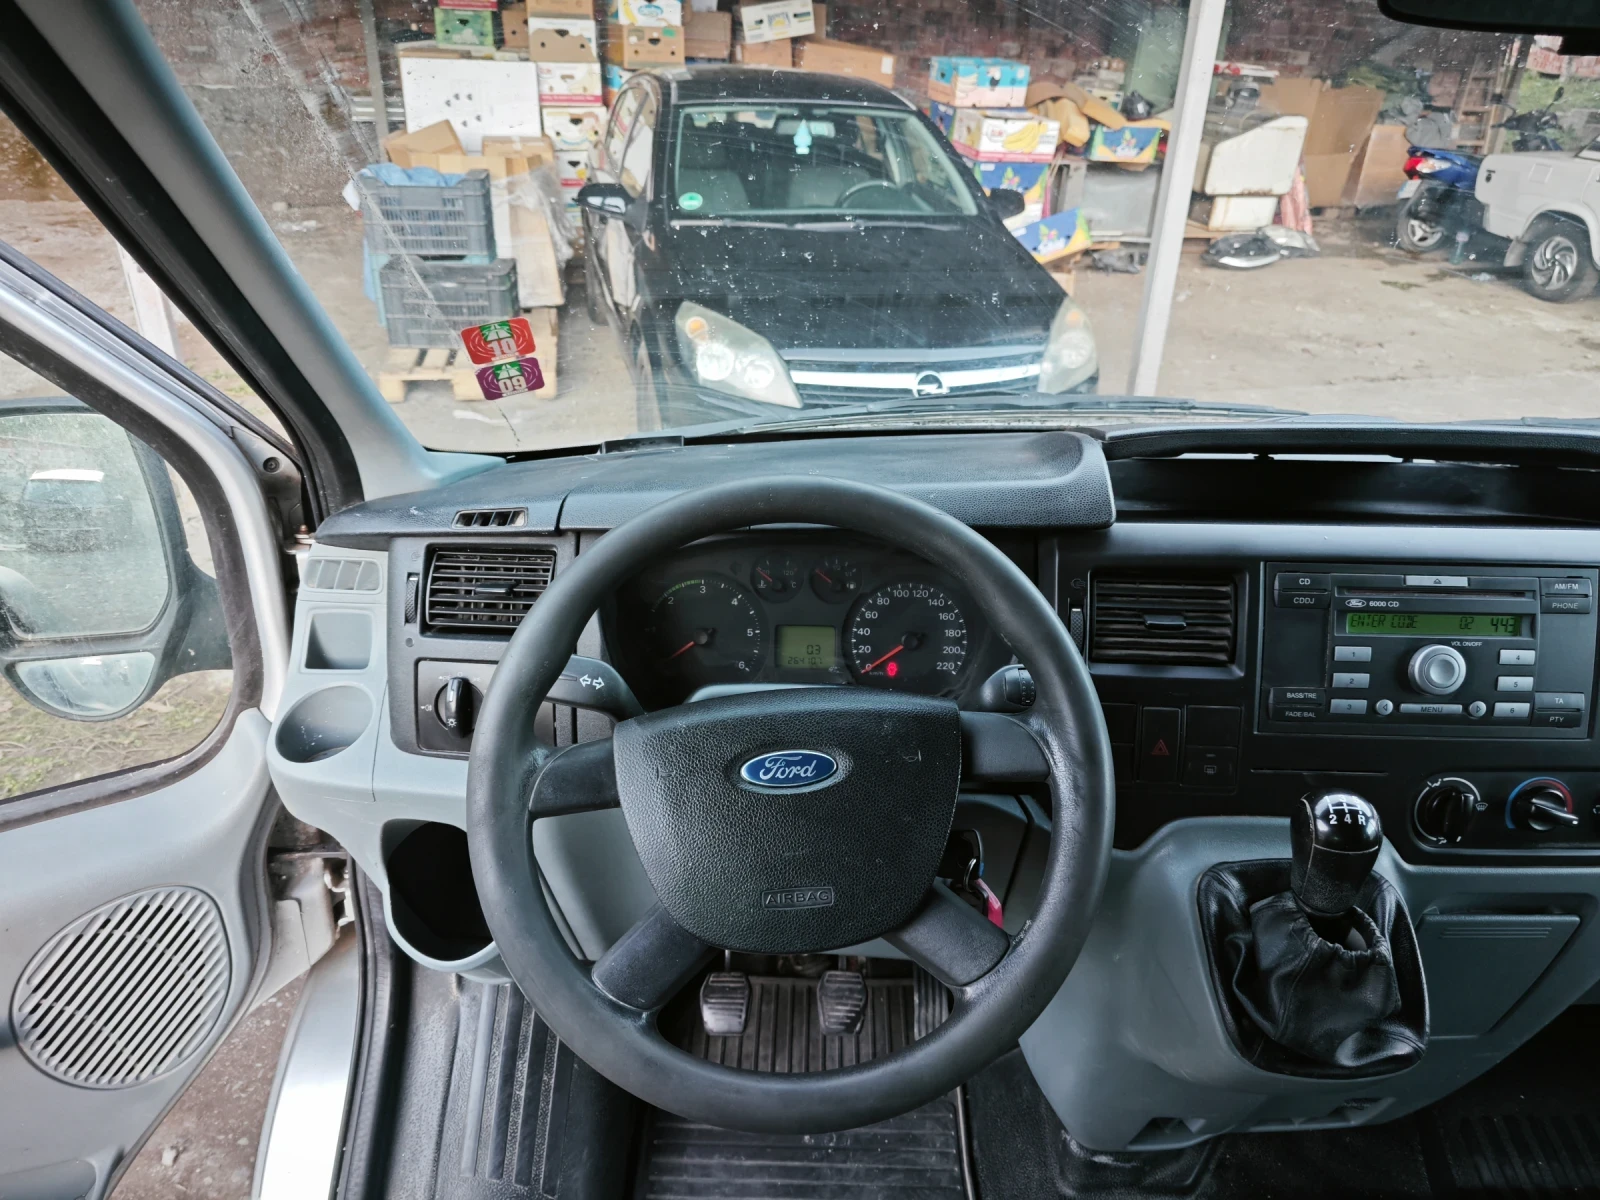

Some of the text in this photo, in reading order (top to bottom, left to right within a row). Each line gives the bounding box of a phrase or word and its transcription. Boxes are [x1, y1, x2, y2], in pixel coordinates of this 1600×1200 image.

[487, 338, 518, 358] 10
[498, 375, 527, 394] 09
[700, 586, 706, 594] 3
[893, 590, 909, 598] 100
[912, 590, 929, 598] 120
[876, 597, 890, 605] 80
[928, 598, 945, 606] 140
[865, 611, 878, 619] 60
[938, 612, 955, 620] 160
[1351, 614, 1385, 628] ENTER
[1391, 615, 1417, 629] CODE
[1459, 616, 1474, 630] 02
[747, 628, 753, 637] 5
[857, 628, 871, 636] 40
[944, 629, 961, 637] 180
[858, 645, 871, 653] 20
[943, 646, 961, 654] 200
[739, 661, 745, 669] 6
[936, 662, 955, 670] 220
[759, 755, 817, 780] Ford
[1329, 813, 1366, 825] 2 4 R
[765, 890, 829, 905] AIRBAG
